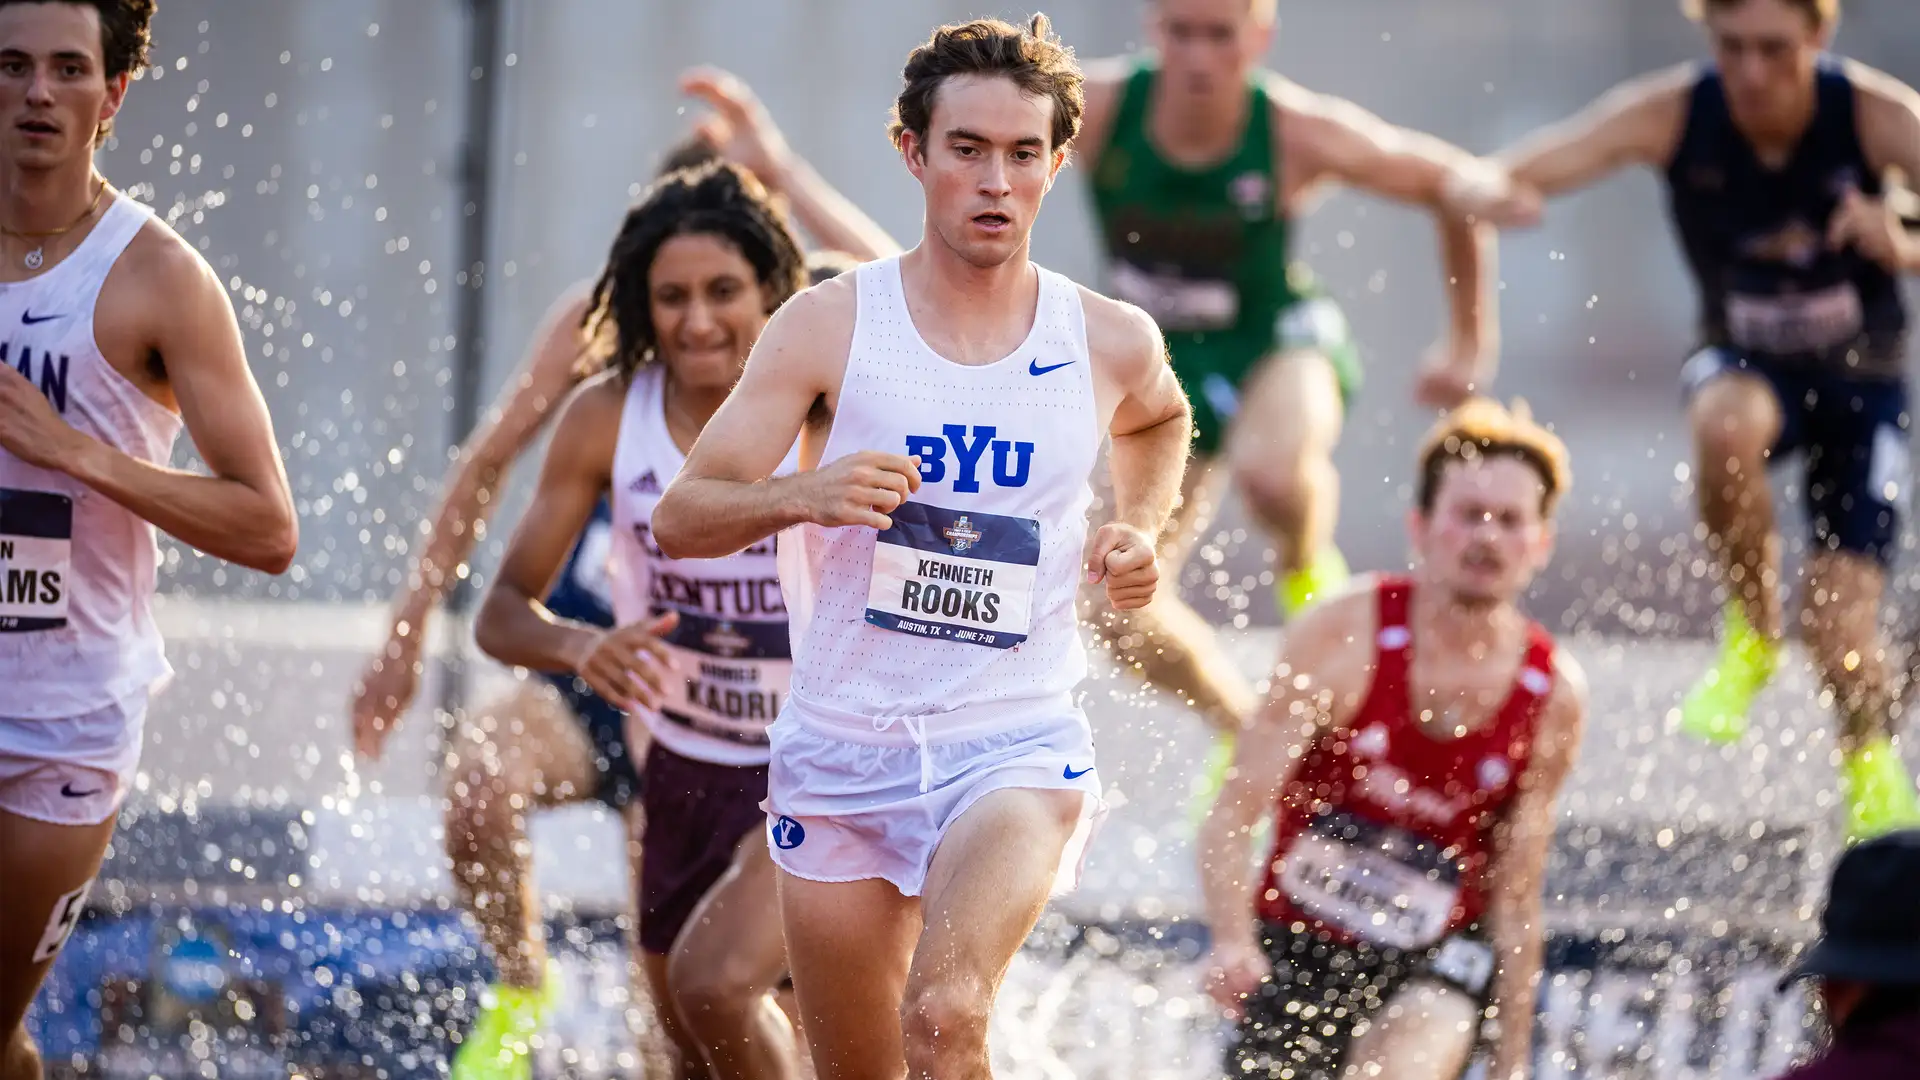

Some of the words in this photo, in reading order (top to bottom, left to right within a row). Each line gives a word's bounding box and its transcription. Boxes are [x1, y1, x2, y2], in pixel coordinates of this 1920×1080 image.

[0, 342, 69, 413] AN
[905, 424, 1035, 493] BYU
[917, 559, 994, 587] KENNETH
[901, 580, 1001, 623] ROOKS
[897, 620, 928, 635] AUSTIN,
[930, 625, 942, 636] TX
[955, 629, 977, 641] JUNE
[978, 633, 996, 644] 7-10
[687, 677, 778, 721] KADRI
[778, 819, 798, 847] Y
